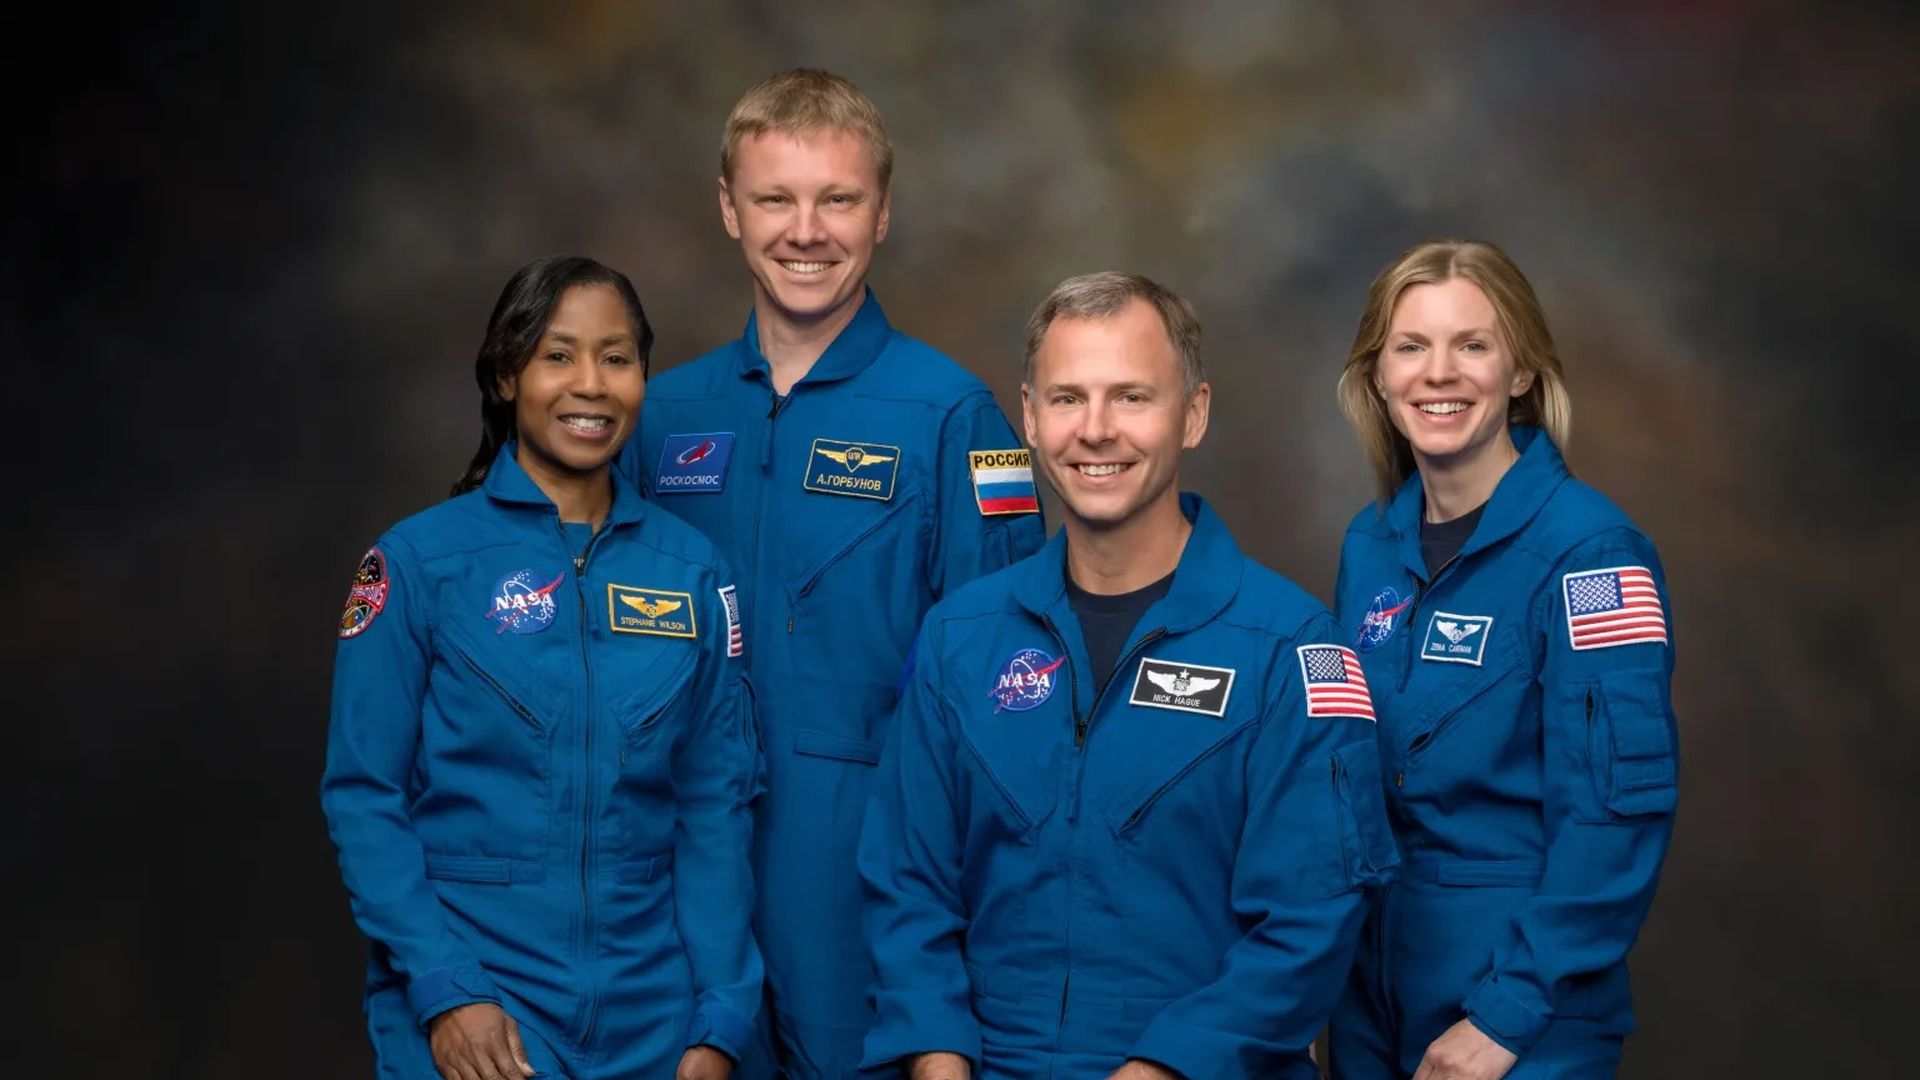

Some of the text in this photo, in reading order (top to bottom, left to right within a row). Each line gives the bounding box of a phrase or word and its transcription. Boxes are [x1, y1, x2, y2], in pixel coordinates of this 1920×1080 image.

[974, 452, 1031, 468] РОССИЯ
[659, 475, 720, 486] РОСКОСМОС
[816, 473, 882, 491] А.ГОРБУНОВ
[495, 592, 555, 611] NASA
[620, 616, 686, 631] STEPHANIE WILSON
[999, 672, 1051, 689] NASA
[1152, 694, 1201, 707] NICK HAGUE
